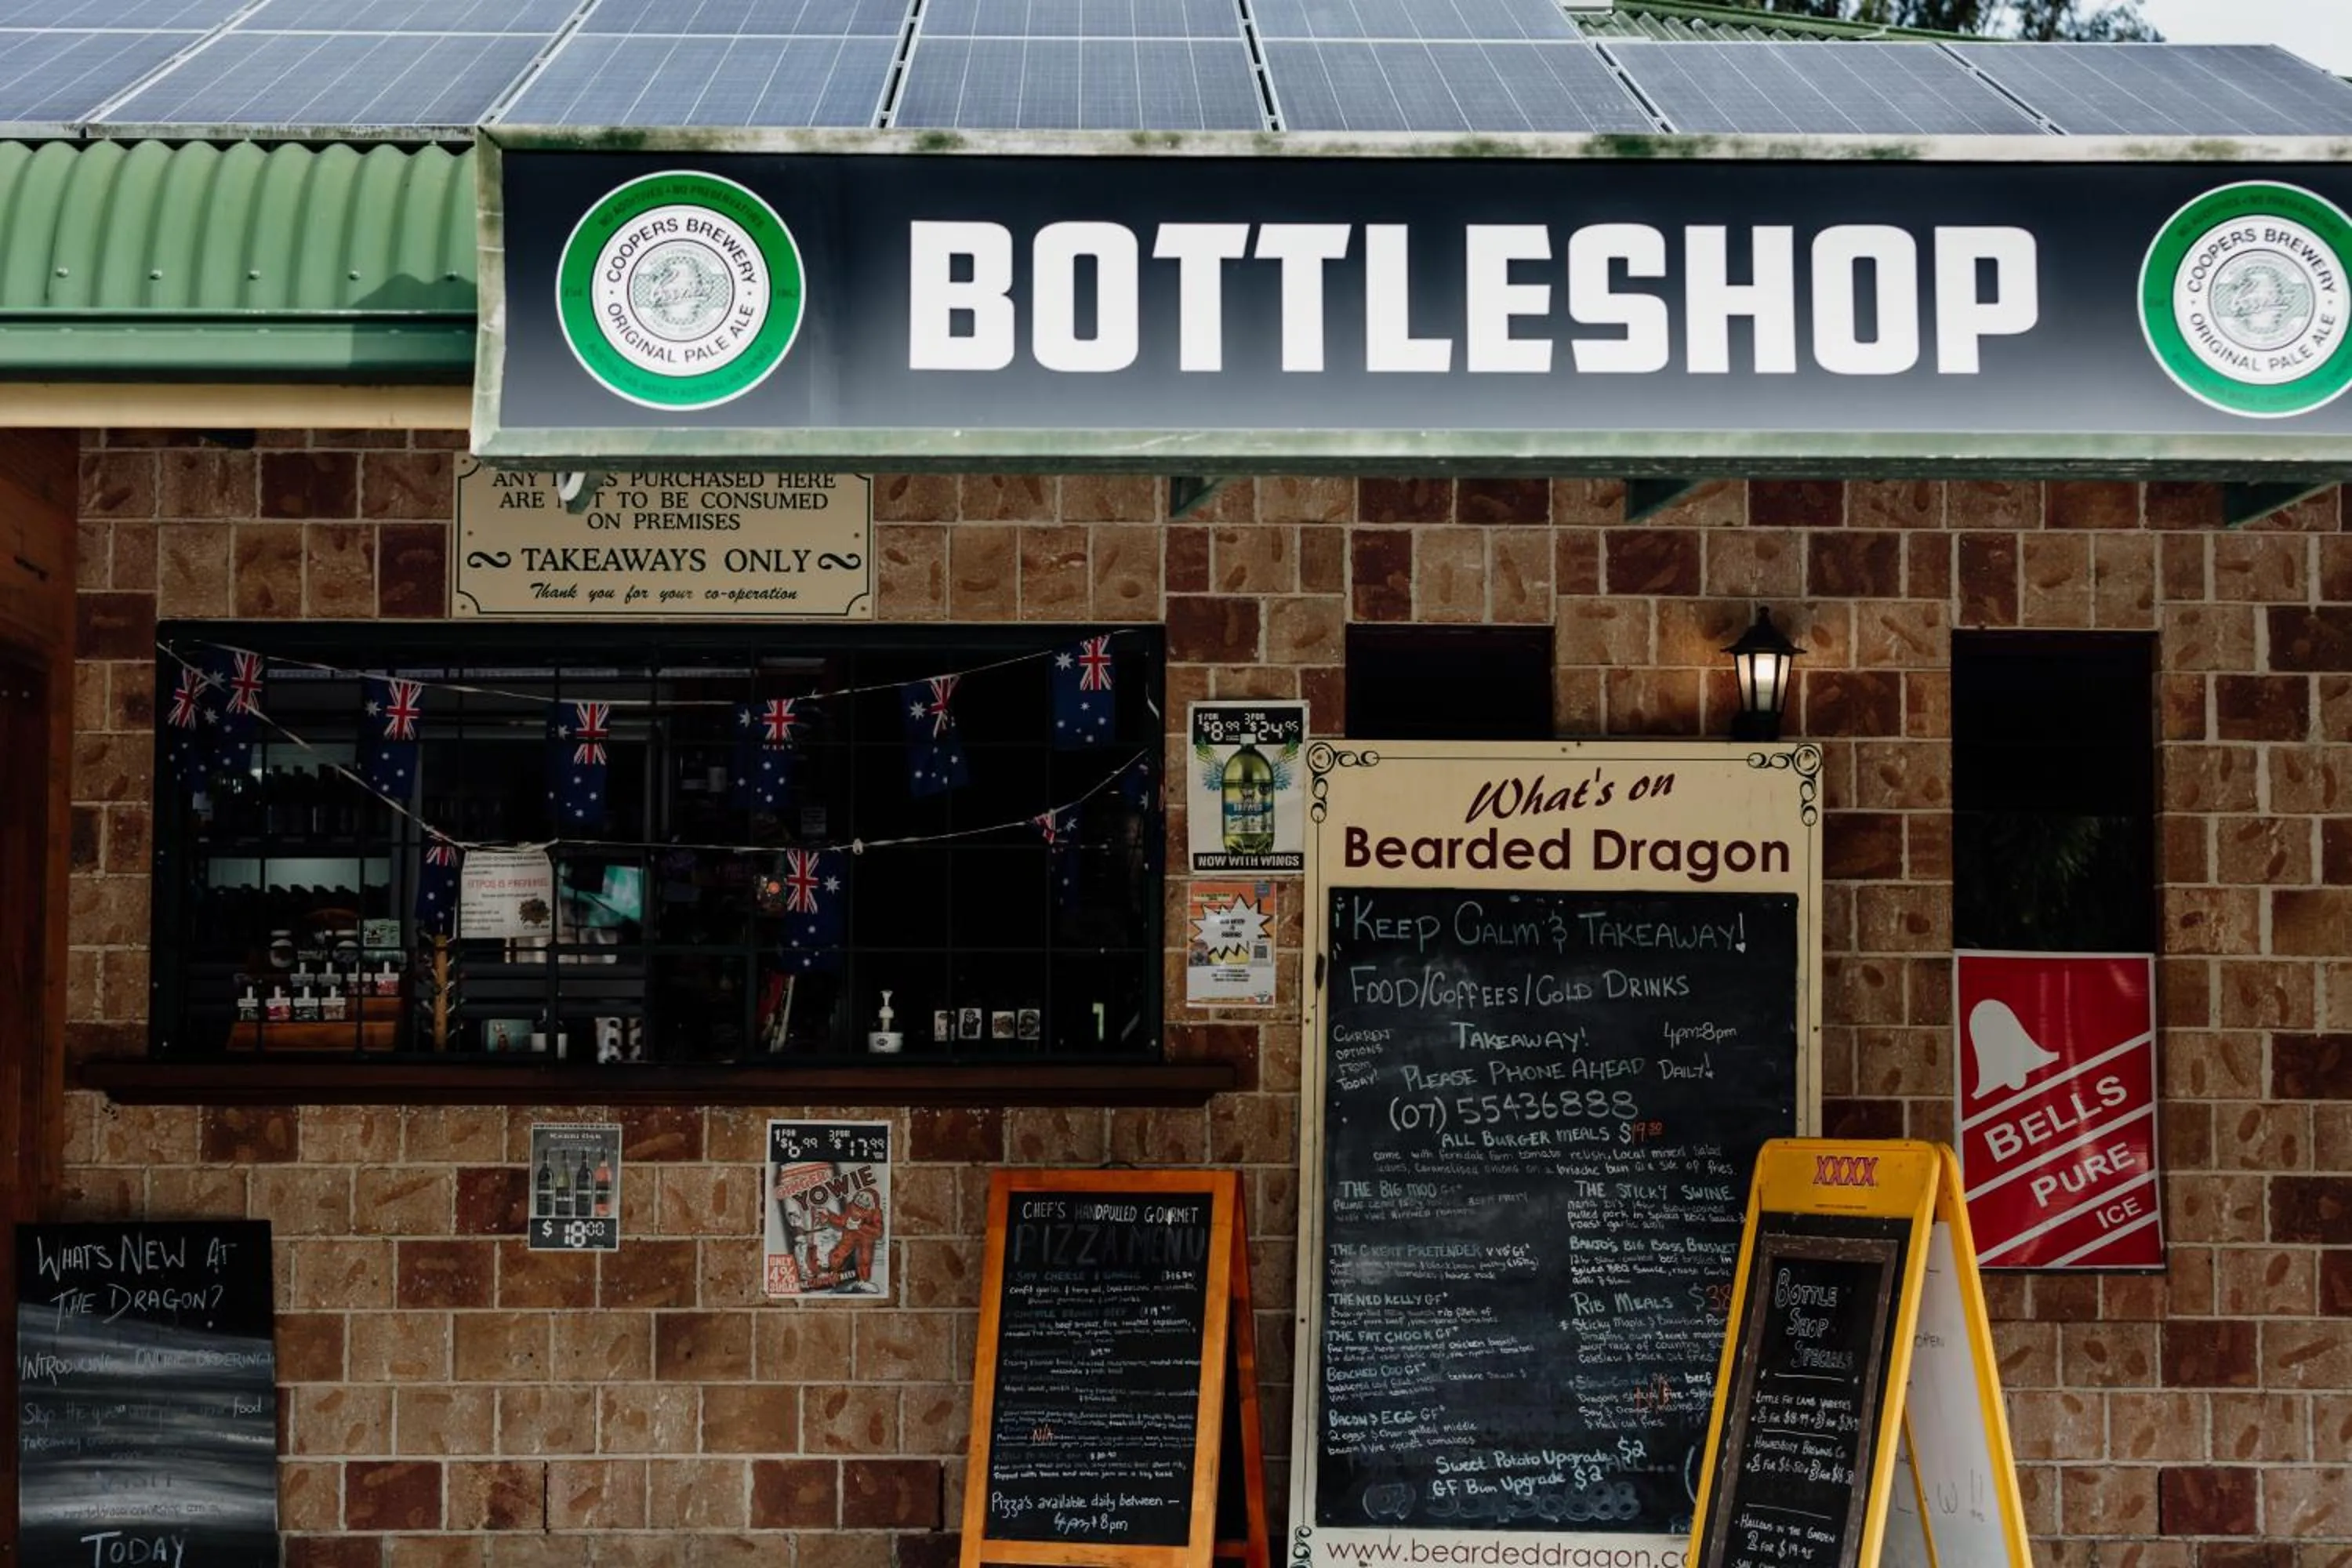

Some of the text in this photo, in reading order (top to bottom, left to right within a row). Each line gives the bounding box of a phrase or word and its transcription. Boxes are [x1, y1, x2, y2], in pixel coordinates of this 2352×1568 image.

[606, 218, 757, 285] COOPERS BREWERY
[2187, 228, 2336, 293] COOPERS BREWERY
[909, 220, 2038, 375] BOTTLESHOP
[608, 303, 754, 363] ORIGINAL PALE ALE
[2190, 313, 2336, 371] ORIGINAL PALE ALE
[492, 472, 538, 488] ANY
[630, 473, 764, 488] PURCHASED
[777, 473, 836, 488] HERE
[499, 492, 545, 509] ARE
[619, 492, 648, 509] TO
[661, 492, 689, 509] BE
[701, 492, 829, 510] CONSUMED
[587, 513, 741, 531] ON PREMISES
[521, 549, 811, 573] TAKEAWAYS ONLY
[530, 583, 797, 602] Thank you for your co-operation
[1465, 767, 1675, 823] What's on
[1198, 855, 1299, 866] NOW WITH WINGS
[1345, 826, 1790, 884] Bearded Dragon
[1602, 969, 1691, 999] DRINKS
[1450, 1021, 1590, 1053] TAKEAWAY!
[1401, 1058, 1645, 1091] PLEASE PHONE AHEAD
[1389, 1097, 1447, 1134] (07)
[1984, 1075, 2128, 1163] BELLS
[1442, 1133, 1475, 1148] ALL
[1481, 1130, 1552, 1147] BURGER
[1813, 1155, 1880, 1186] XXXX
[2030, 1142, 2136, 1208] PURE
[792, 1165, 877, 1210] YOWIE
[1574, 1180, 1606, 1198] THE
[1681, 1184, 1735, 1201] SWINE
[2096, 1197, 2143, 1229] ICE
[121, 1232, 186, 1275] NEW
[1436, 1456, 1487, 1475] Sweet
[1493, 1450, 1541, 1468] Potato
[1432, 1465, 1604, 1497] GF Bun Upgrade $2
[81, 1531, 186, 1568] TODAY
